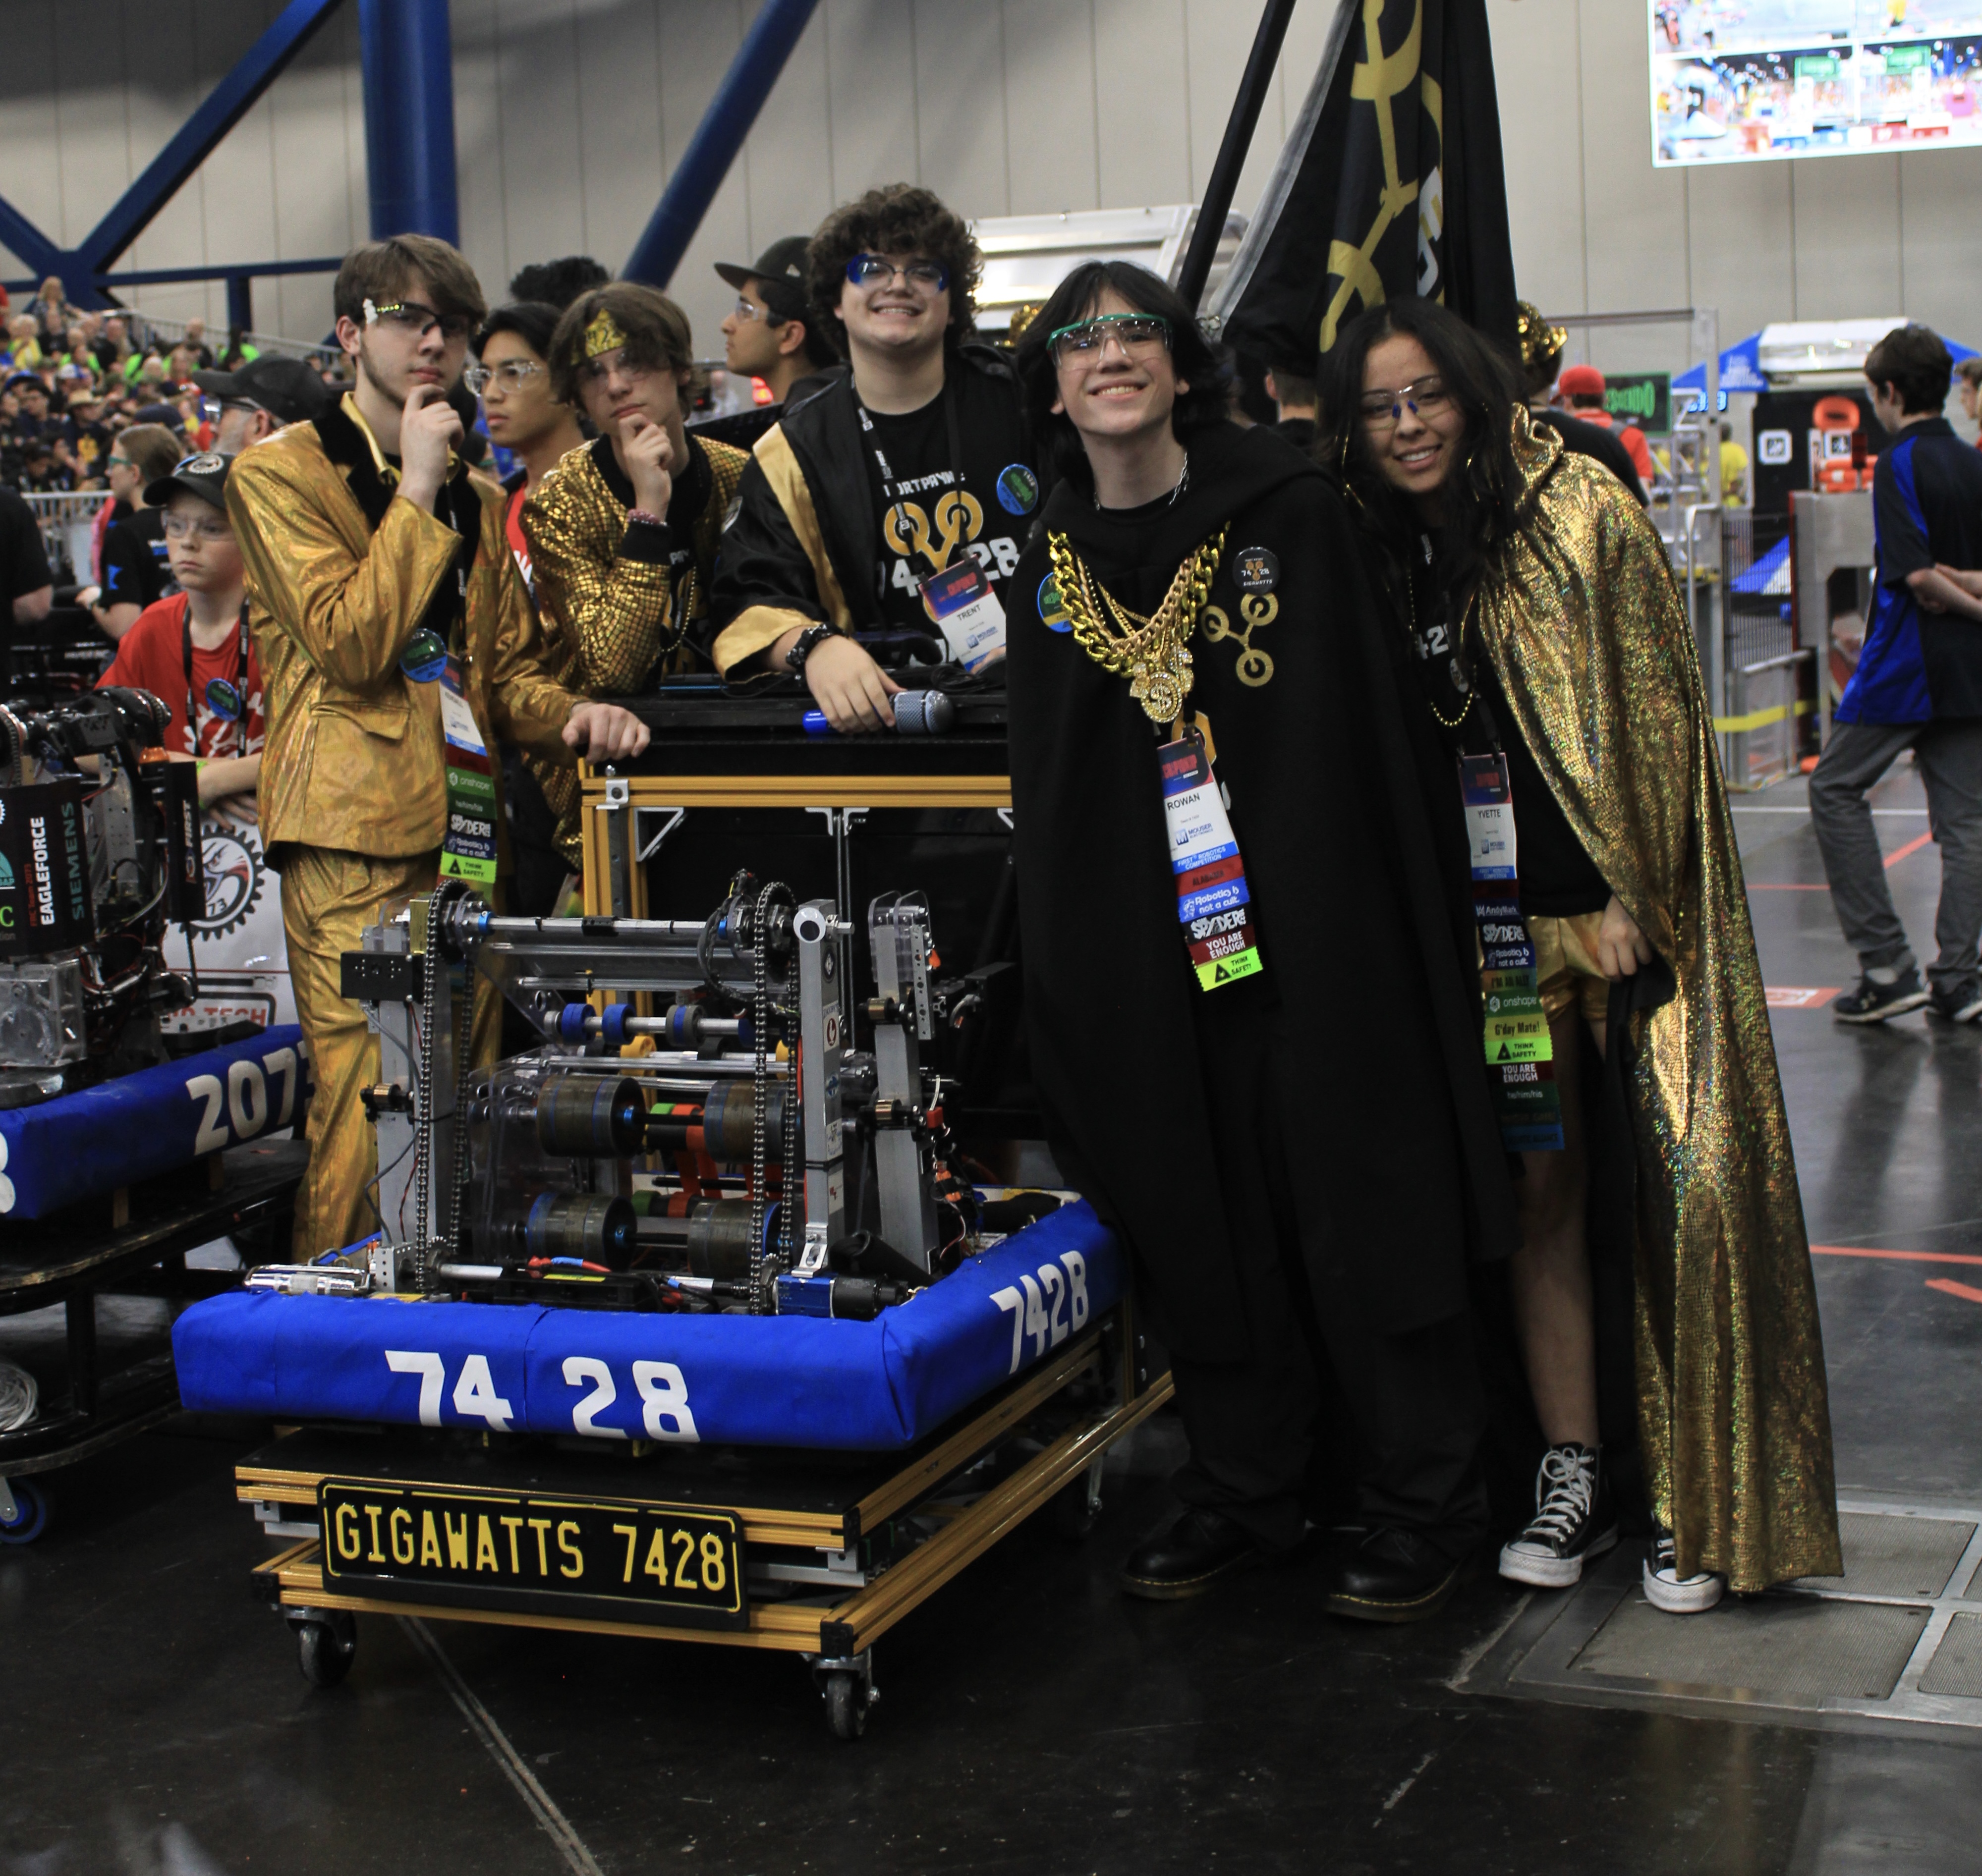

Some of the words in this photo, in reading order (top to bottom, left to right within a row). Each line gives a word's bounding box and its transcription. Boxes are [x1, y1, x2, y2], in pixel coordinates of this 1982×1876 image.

[957, 604, 981, 621] TRENT
[1167, 793, 1200, 811] ROWAN
[1477, 809, 1501, 818] YVETTE
[1189, 822, 1212, 834] MOUSER
[61, 801, 84, 921] SIEMENS
[1185, 853, 1222, 870] COMPETITION
[1198, 846, 1226, 860] ROBOTICS
[30, 817, 55, 926] EAGLEFORCE
[1195, 889, 1232, 906] Robotics
[1199, 903, 1214, 914] not
[1206, 937, 1227, 950] YOU
[1228, 931, 1244, 943] ARE
[1209, 939, 1246, 959] ENOUGH
[1231, 956, 1248, 966] THINK
[1231, 963, 1251, 975] SAFETY
[1503, 995, 1537, 1007] onshape
[1494, 1024, 1516, 1037] G'day
[1517, 1021, 1540, 1033] Mate!
[1502, 1064, 1518, 1074] YOU
[1519, 1063, 1536, 1073] ARE
[1503, 1072, 1538, 1083] ENOUGH
[990, 1250, 1089, 1375] 7428
[385, 1350, 513, 1433] 74
[562, 1356, 700, 1442] 28
[335, 1502, 585, 1579] GIGAWATTS
[613, 1523, 727, 1592] 7428
